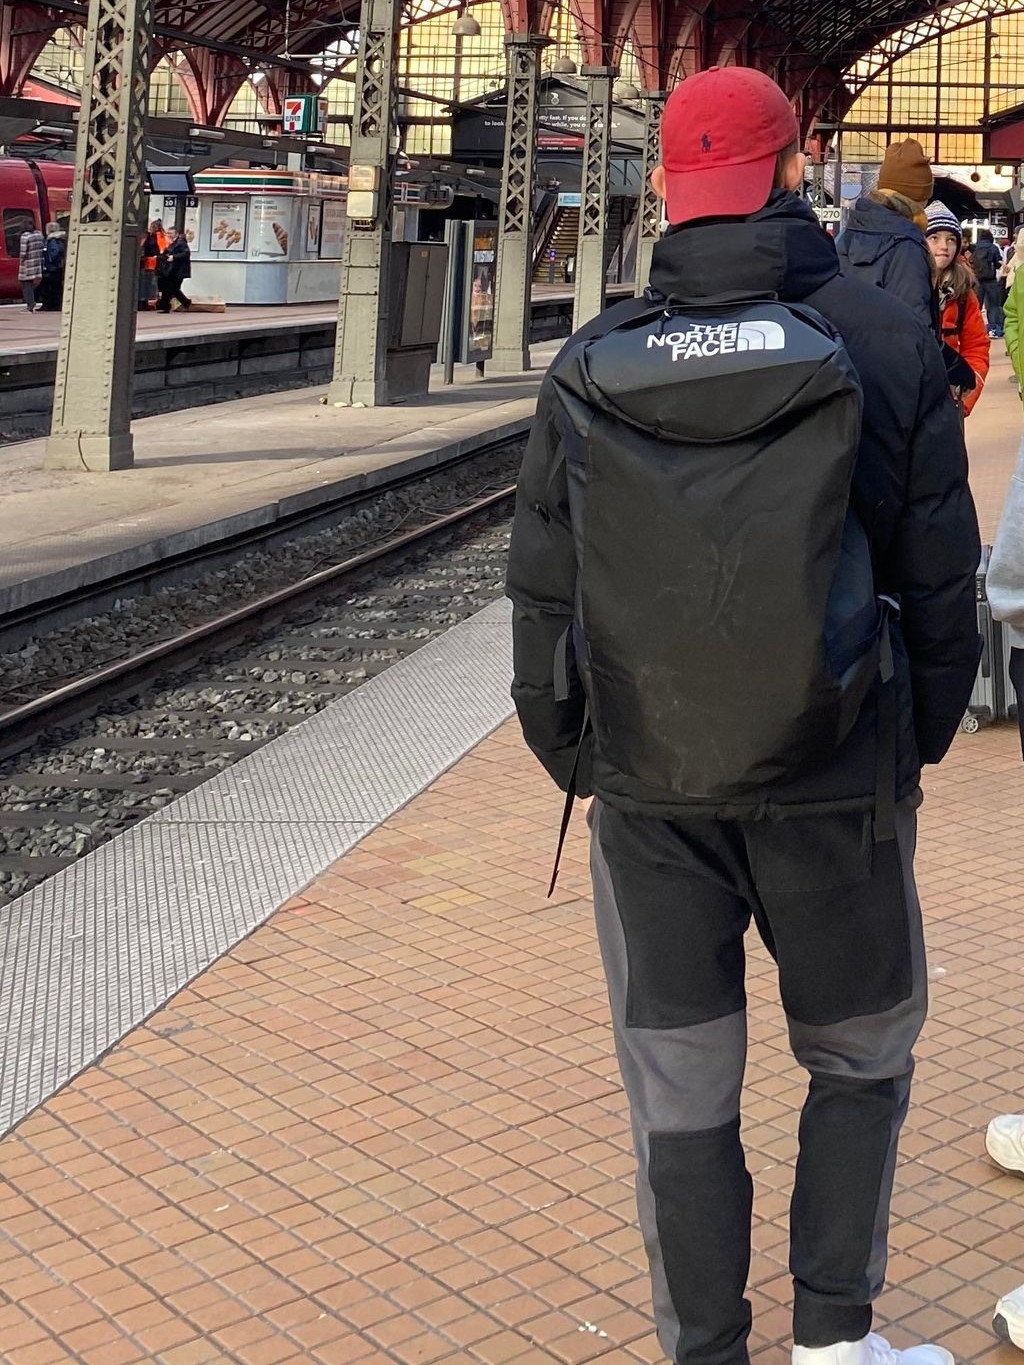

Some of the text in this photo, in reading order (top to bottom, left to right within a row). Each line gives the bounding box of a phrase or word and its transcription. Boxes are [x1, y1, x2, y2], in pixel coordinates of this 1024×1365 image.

[823, 210, 840, 219] 270
[689, 322, 739, 334] THE
[646, 329, 738, 349] NORTH
[671, 339, 736, 362] FACE
